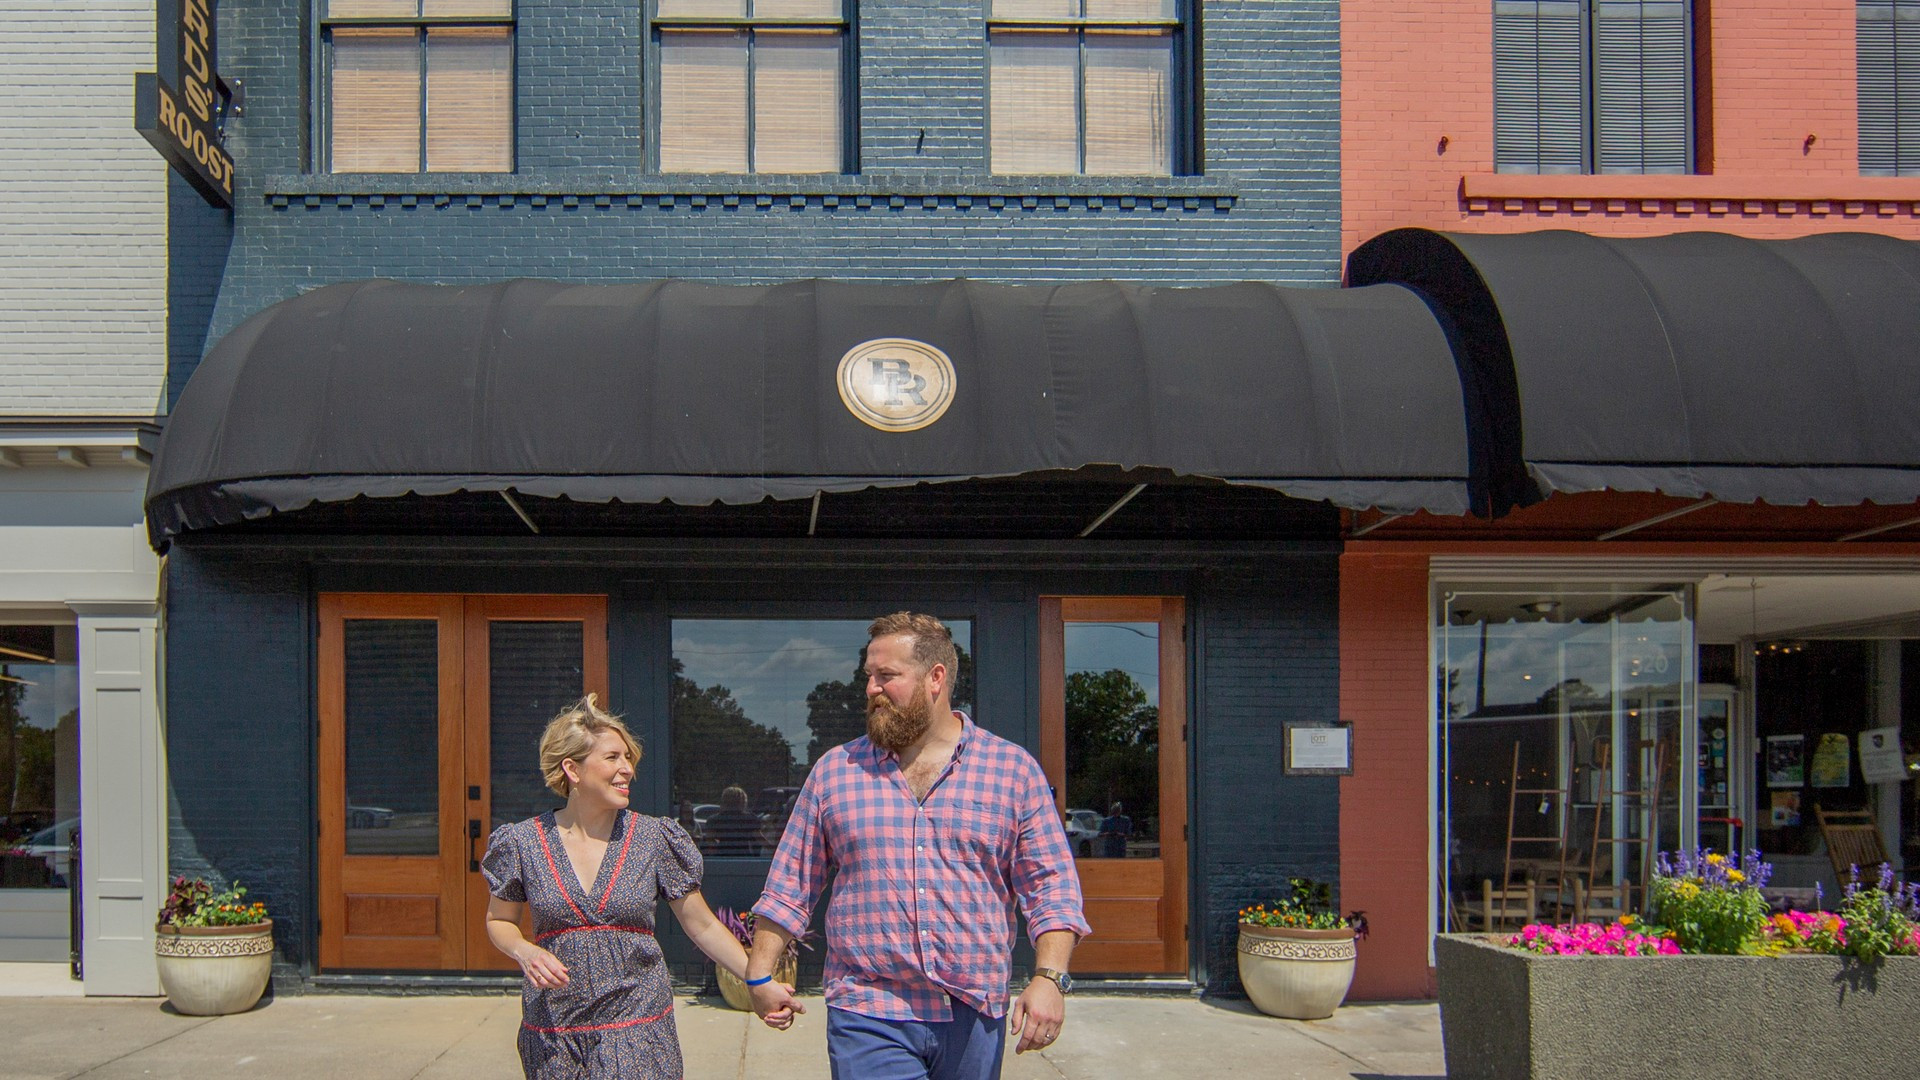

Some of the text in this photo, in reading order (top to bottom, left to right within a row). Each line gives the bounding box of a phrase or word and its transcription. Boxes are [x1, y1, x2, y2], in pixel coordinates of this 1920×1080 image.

[183, 0, 213, 122] RDS'
[159, 88, 234, 194] ROOST
[867, 357, 928, 406] BR
